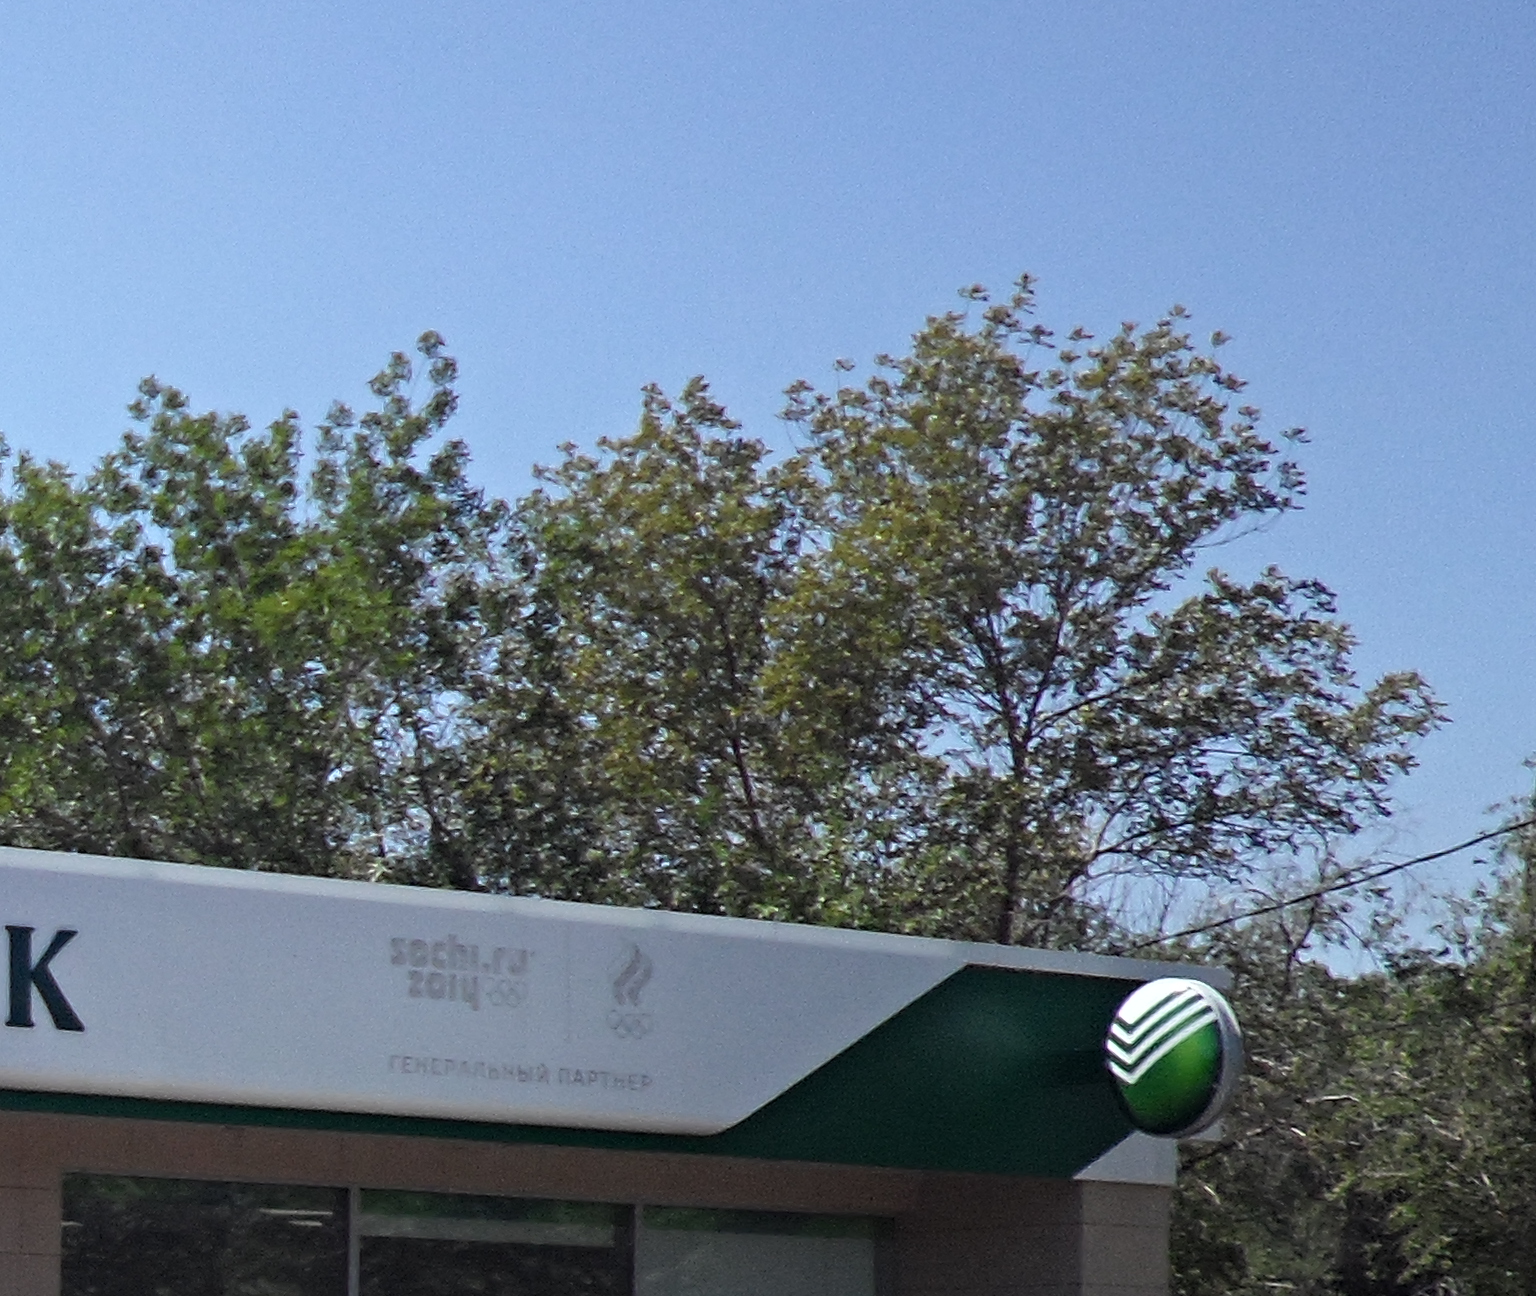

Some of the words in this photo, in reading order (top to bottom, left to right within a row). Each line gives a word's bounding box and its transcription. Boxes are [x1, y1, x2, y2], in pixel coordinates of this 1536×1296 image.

[389, 934, 528, 975] sochi.ru
[407, 969, 479, 1011] 2014
[387, 1054, 550, 1085] ГЕНЕРАЛЬНЫЙ
[557, 1066, 654, 1091] ПАРТНЕР
